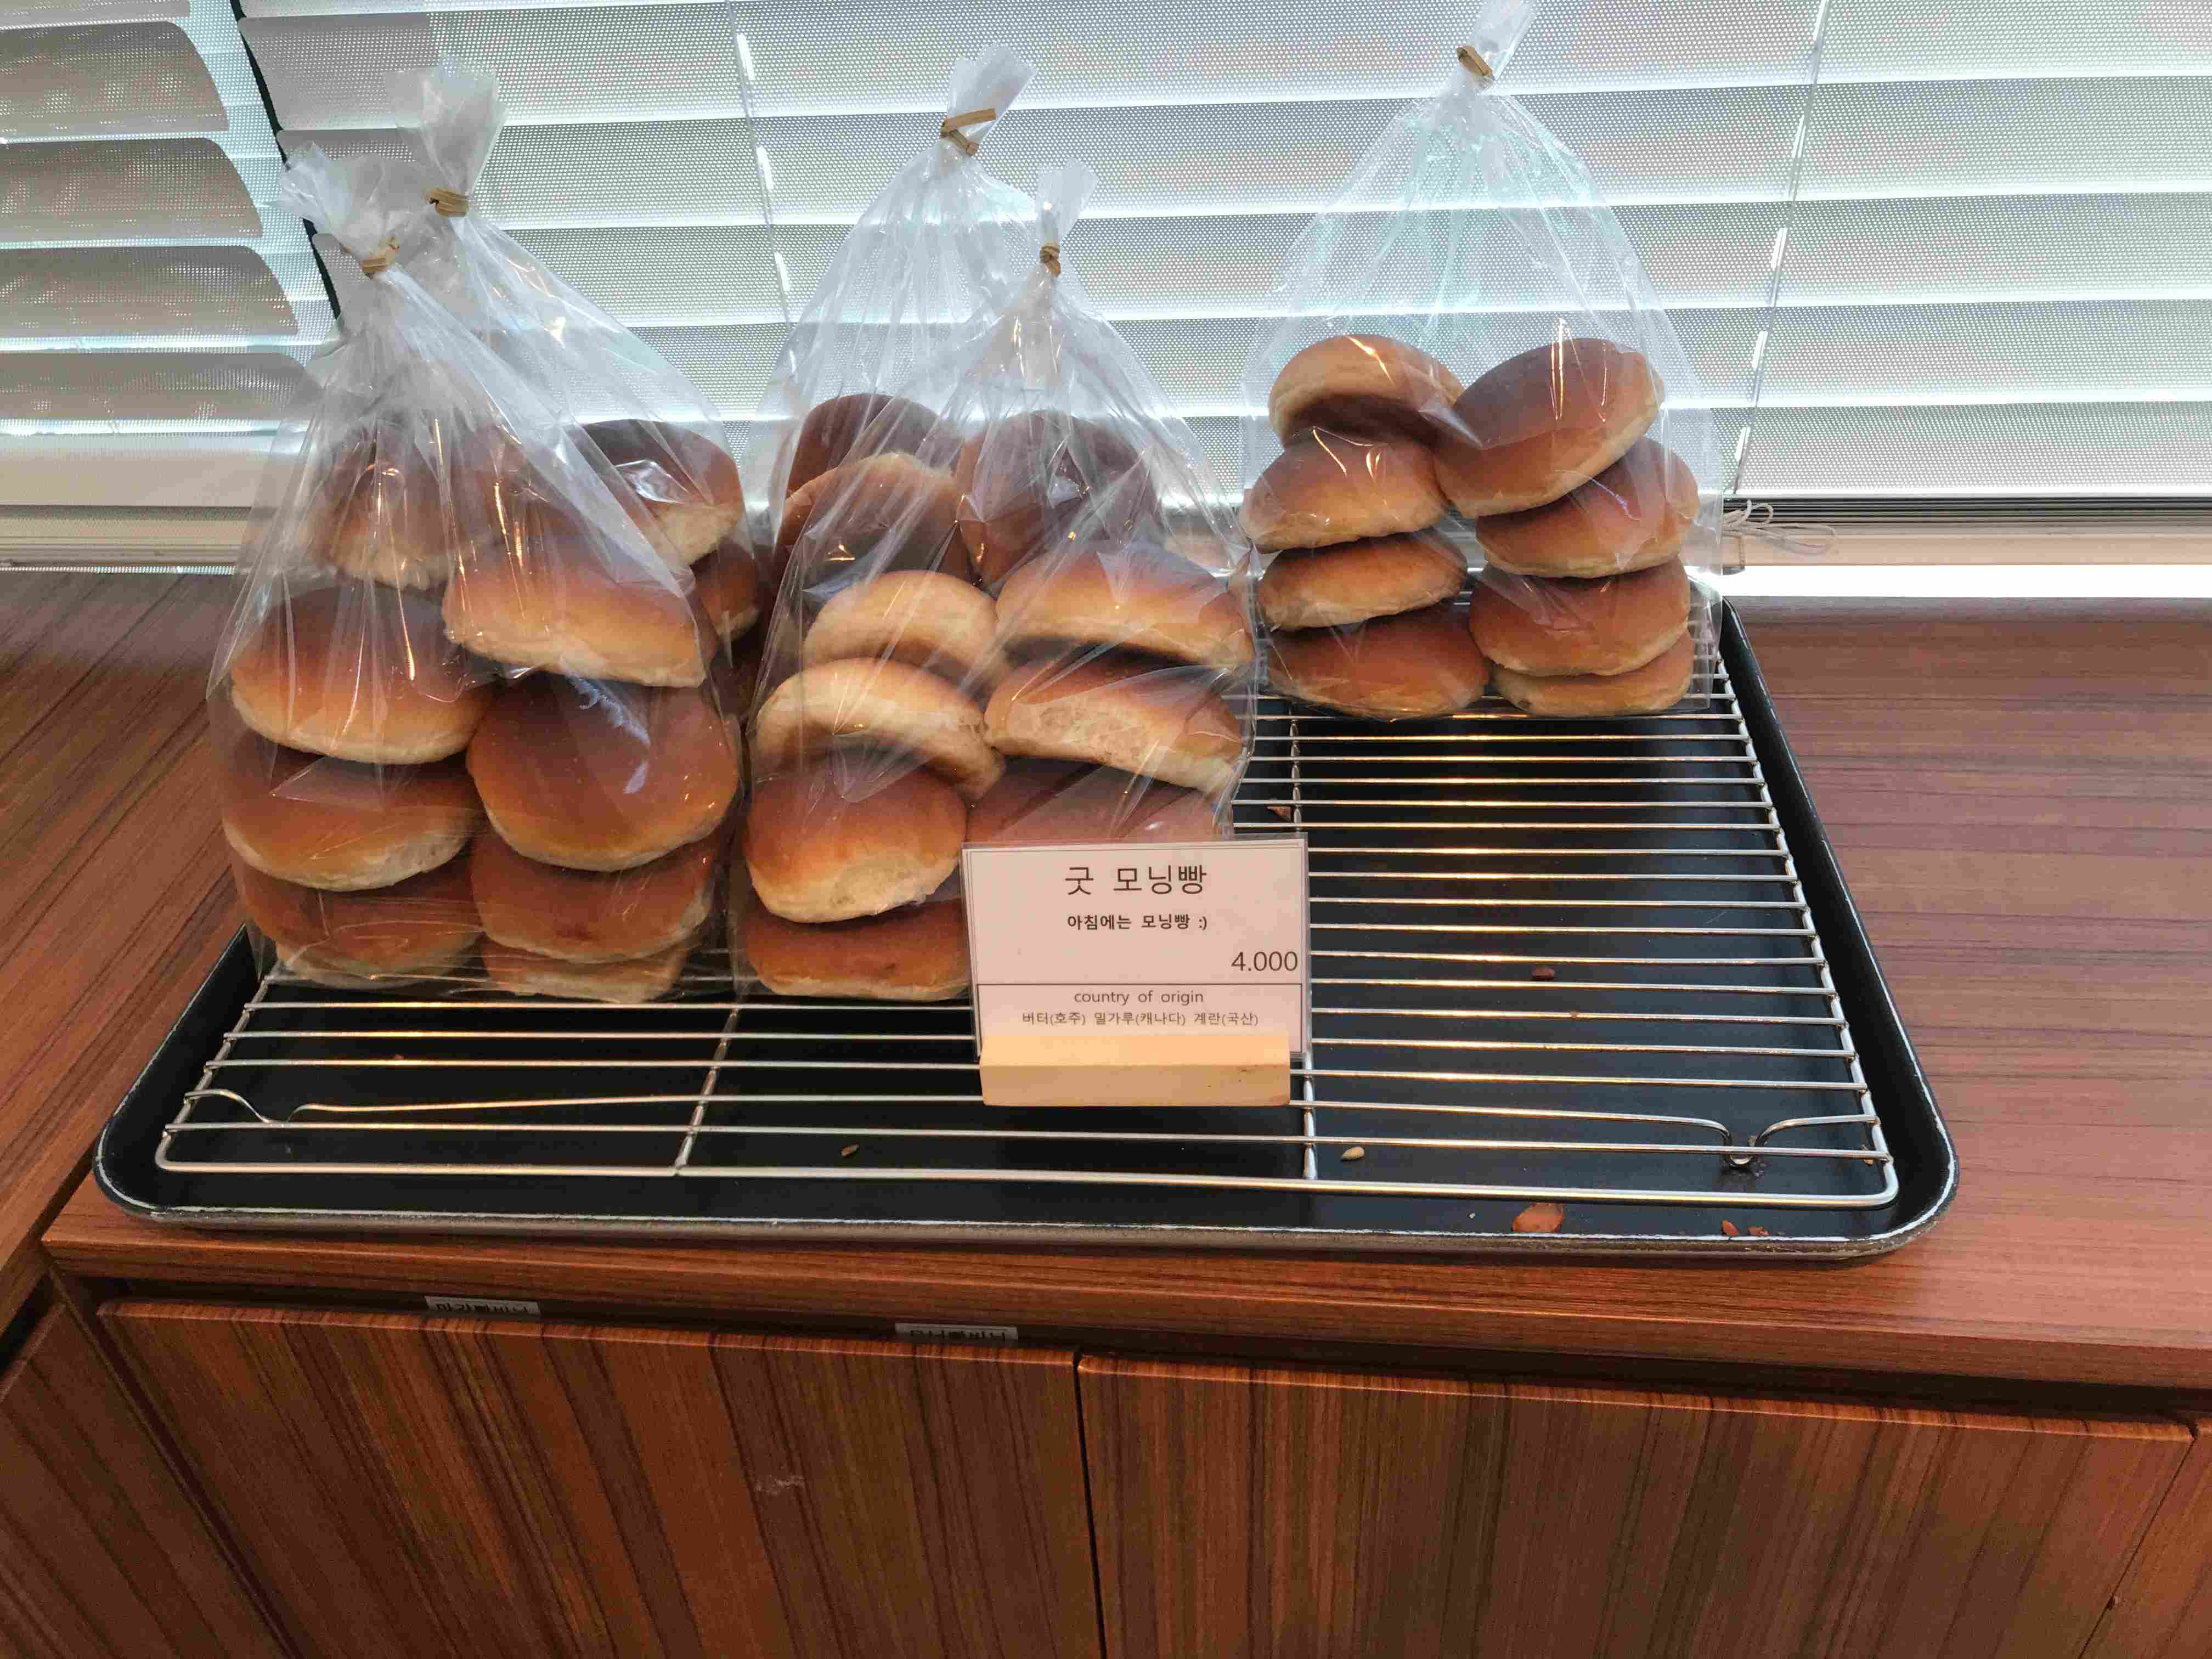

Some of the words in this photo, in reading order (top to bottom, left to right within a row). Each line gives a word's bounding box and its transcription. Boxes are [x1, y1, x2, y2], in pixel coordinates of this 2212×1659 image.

[1064, 866, 1094, 896] 굿
[1113, 864, 1207, 895] 모닝빵
[1067, 914, 1132, 931] 아침에는
[1141, 913, 1191, 930] 모닝빵
[1231, 951, 1298, 972] 4.000
[1074, 991, 1130, 1007] country
[1137, 990, 1154, 1003] of
[1160, 990, 1204, 1007] origin
[1022, 1012, 1086, 1026] 버터(호주)
[1094, 1012, 1186, 1026] 밀가루(캐나다)
[1194, 1012, 1259, 1026] 계란(국산)
